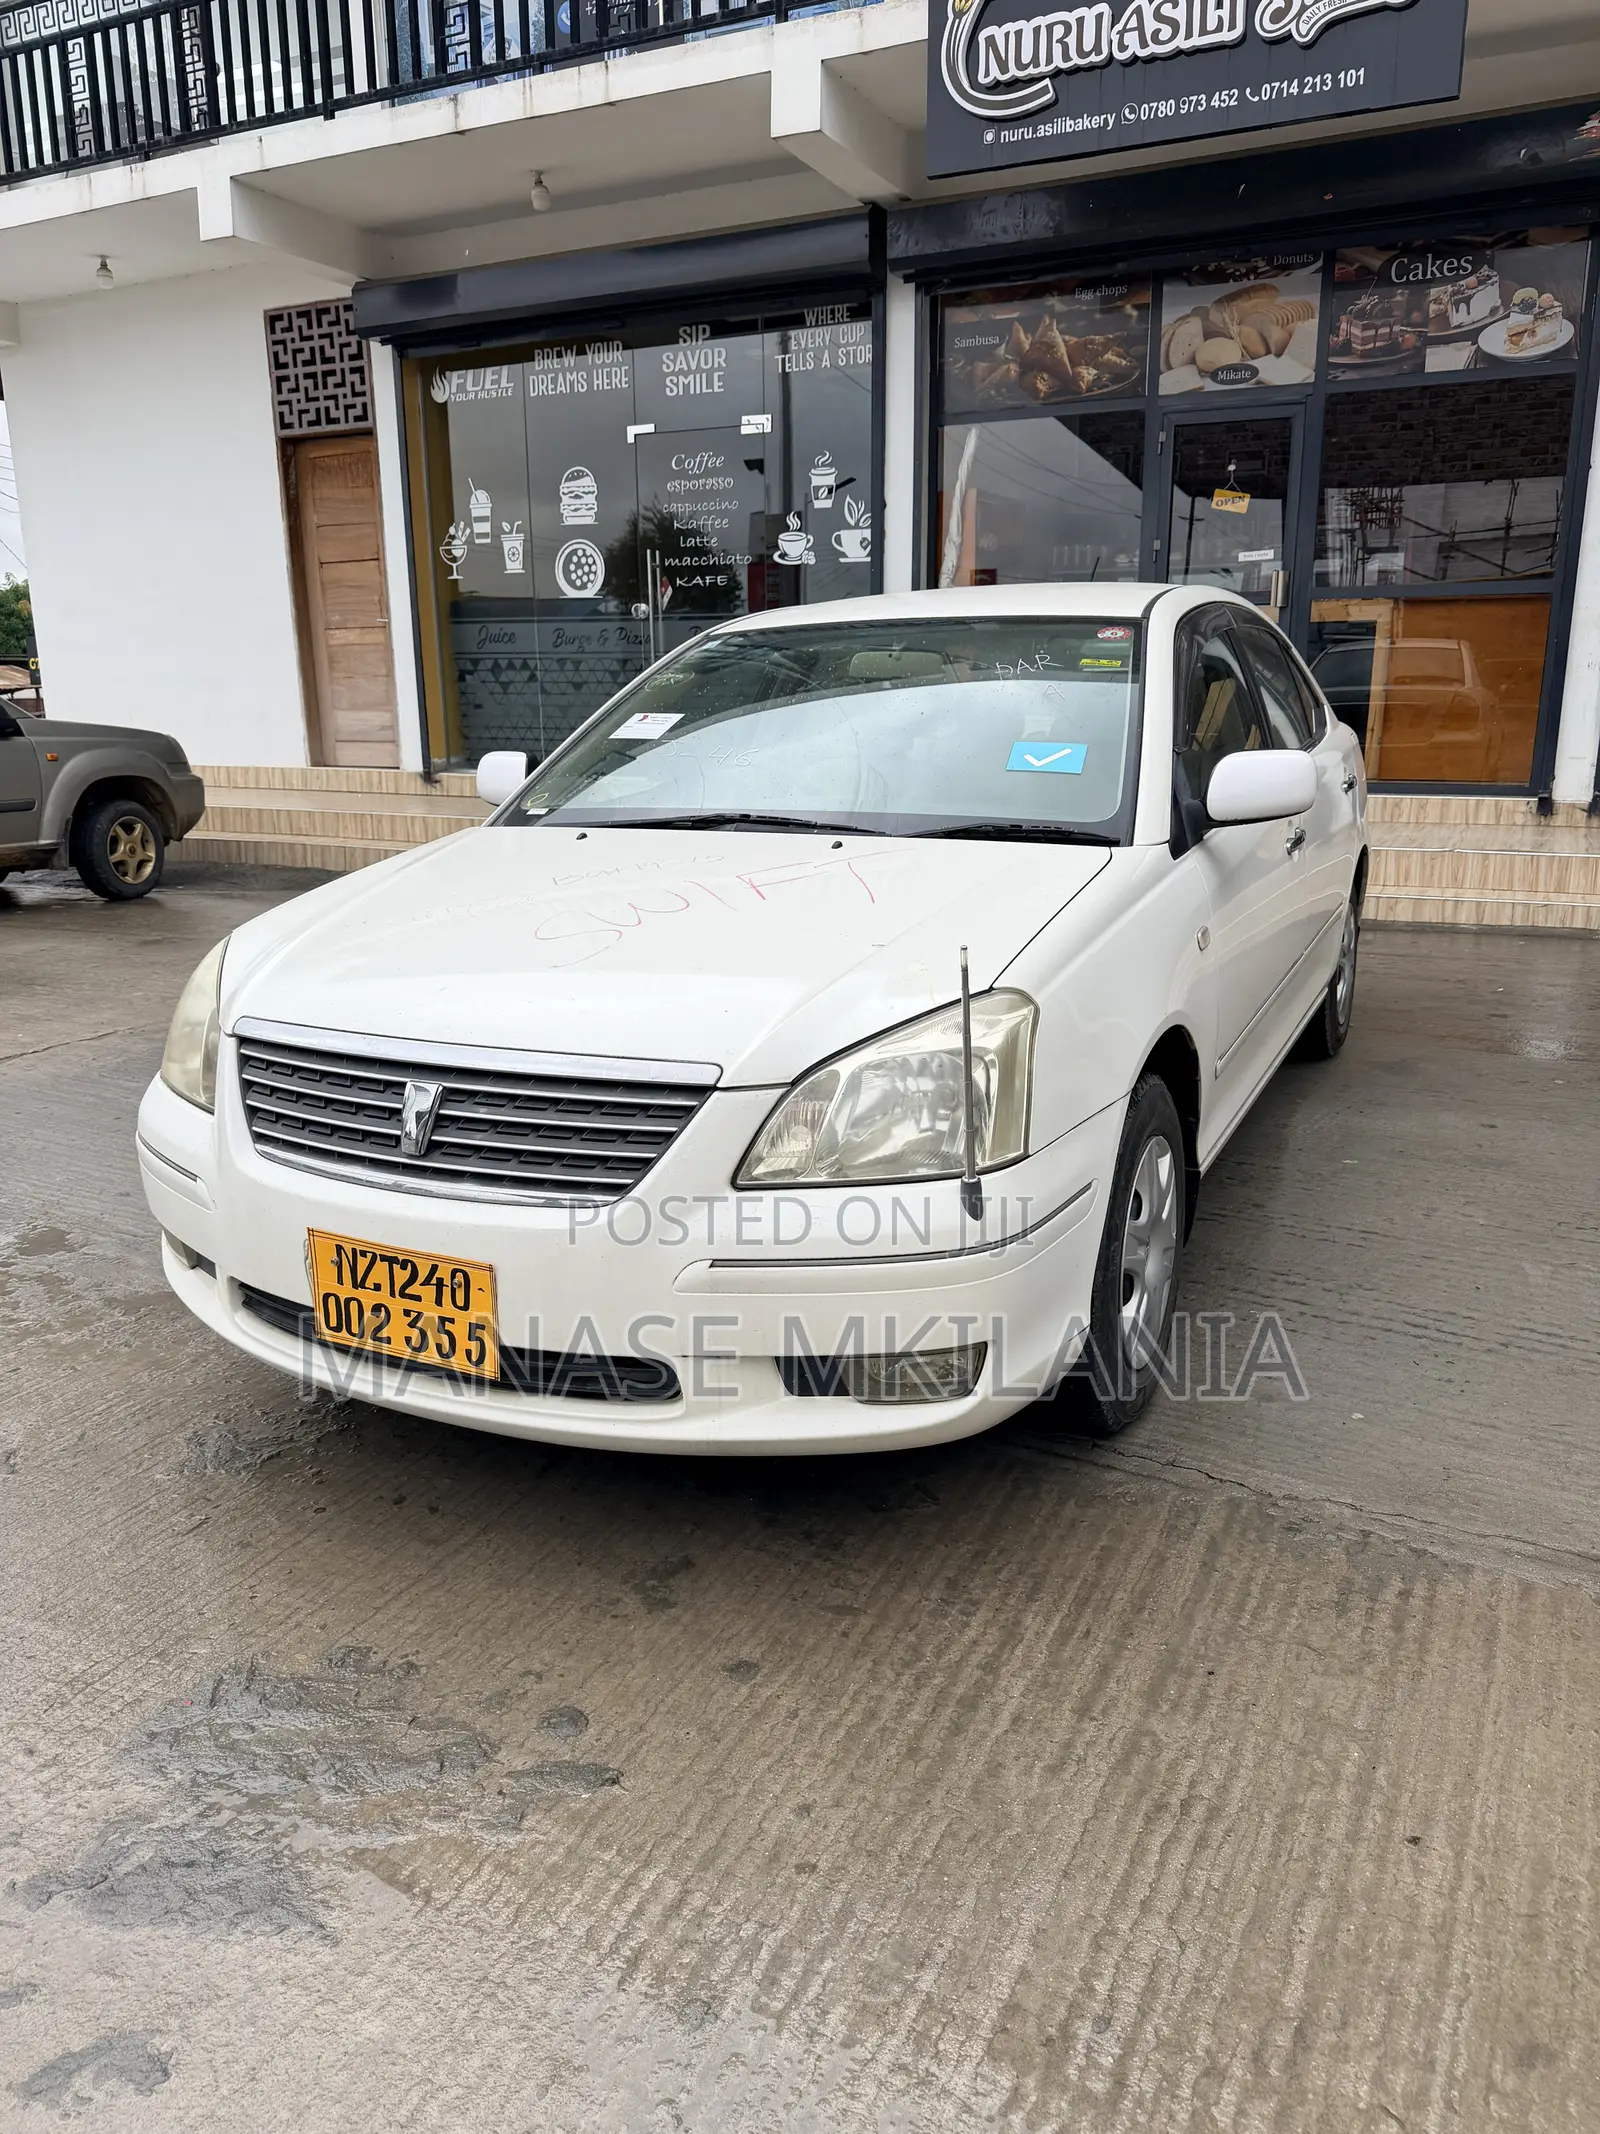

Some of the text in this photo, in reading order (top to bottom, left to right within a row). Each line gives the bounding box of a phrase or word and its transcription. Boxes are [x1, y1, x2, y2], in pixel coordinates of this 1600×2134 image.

[1302, 6, 1322, 25] DAILY
[983, 11, 1105, 79] NURU
[1115, 0, 1238, 50] ASILI
[1000, 67, 1366, 143] nuru.asilibakery 0780 973 452 0714 213 101
[1273, 252, 1315, 266] Donuts
[1390, 253, 1474, 284] Cakes
[1075, 283, 1128, 300] Egg chops
[804, 304, 853, 326] WHERE
[678, 324, 711, 347] SIP
[791, 325, 865, 350] EVERY CUP
[954, 334, 1000, 348] Sambusa
[534, 341, 623, 371] BREW YOUR
[662, 347, 728, 373] SAVOR
[775, 352, 816, 373] TELLS
[821, 349, 831, 369] A
[450, 365, 514, 393] FUEL
[529, 366, 630, 398] DREAMS HERE
[665, 372, 725, 397] SMILE
[1217, 368, 1252, 382] Mikate
[450, 387, 514, 402] YOUR HUSTLE
[671, 451, 725, 475] Coffee
[662, 497, 740, 517] cappuccino
[1215, 495, 1246, 508] OPEN
[680, 535, 719, 548] latte
[664, 552, 753, 567] macchiato
[676, 575, 729, 587] KAFE
[476, 625, 518, 650] Juice
[597, 628, 609, 648] &
[534, 848, 917, 968] SWIFT
[334, 1243, 471, 1312] NZT240
